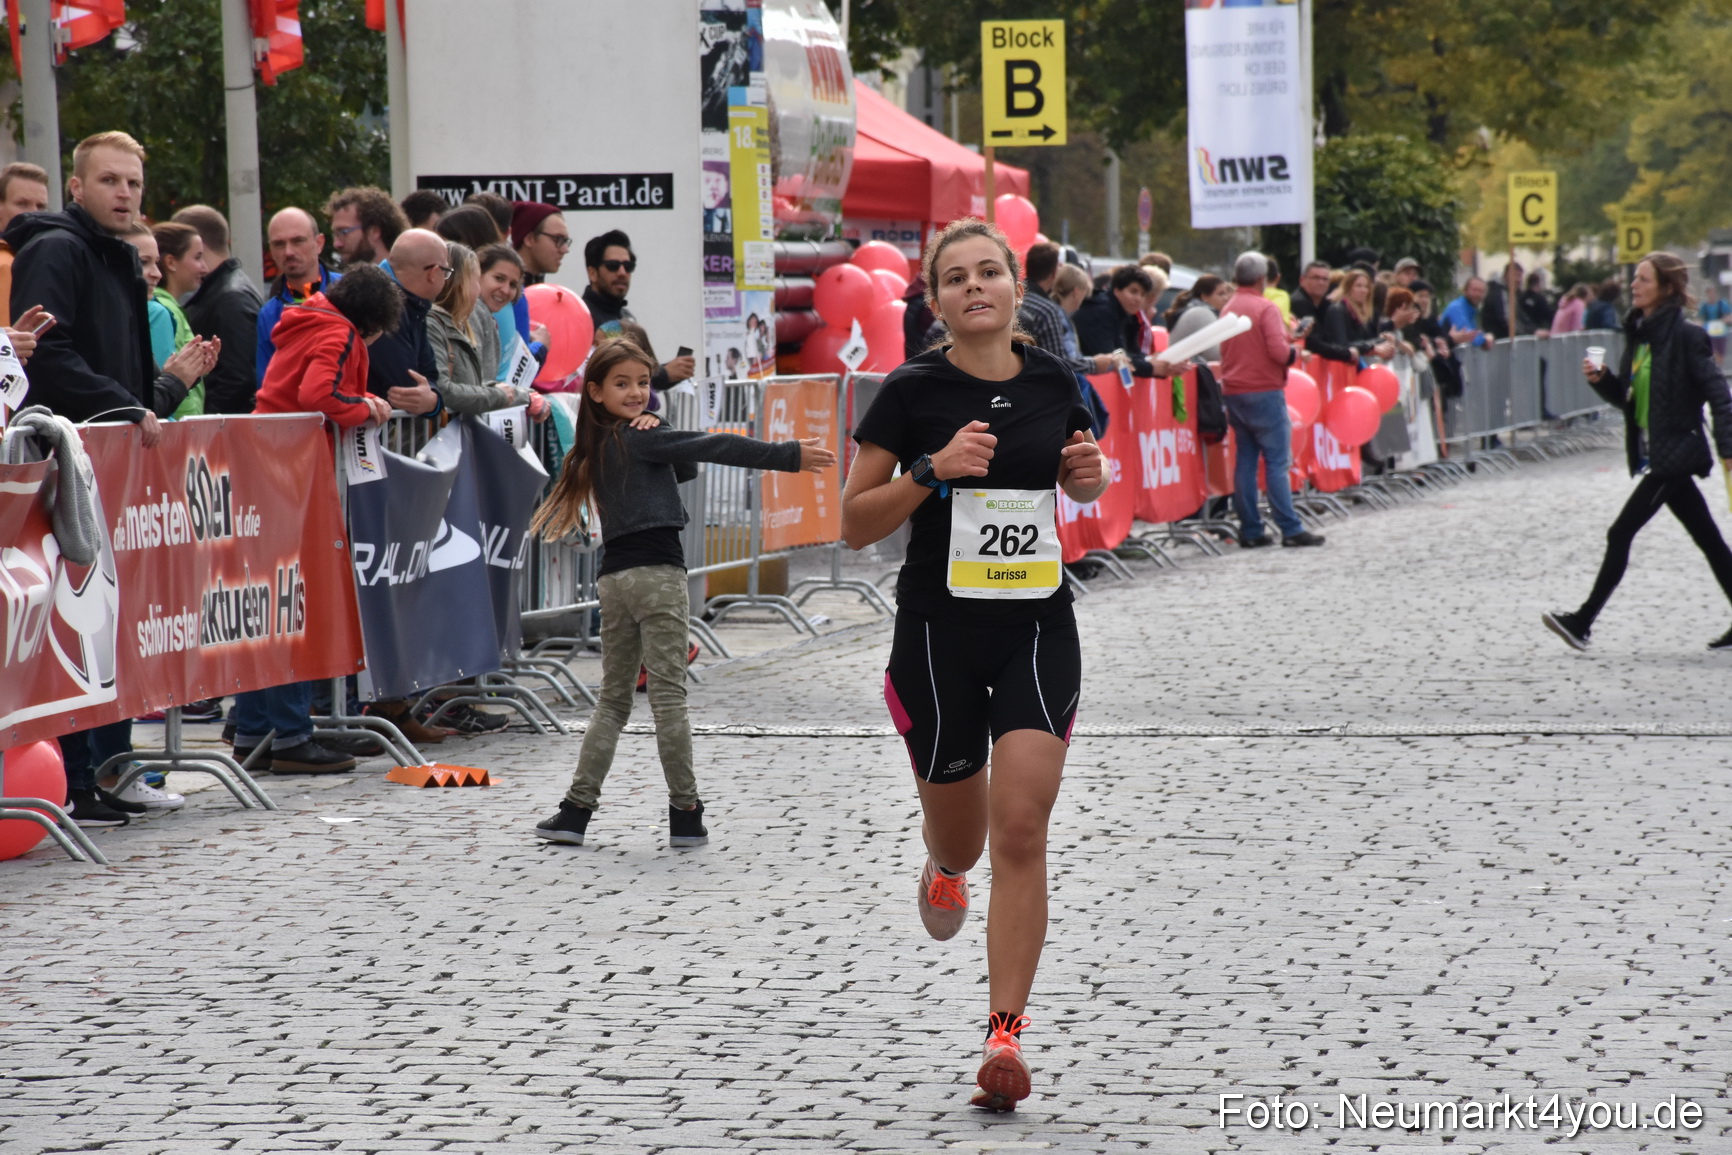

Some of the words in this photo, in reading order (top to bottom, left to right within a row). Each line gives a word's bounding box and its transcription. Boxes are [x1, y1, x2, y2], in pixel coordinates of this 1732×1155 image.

[992, 27, 1054, 48] Block
[1005, 60, 1044, 118] B
[733, 125, 757, 148] 18.
[1514, 176, 1550, 188] Block
[1520, 193, 1544, 226] C
[1626, 227, 1644, 251] D
[126, 486, 191, 550] meisten
[186, 456, 233, 543] 80er
[998, 500, 1035, 509] BOCK
[979, 524, 1039, 557] 262
[987, 568, 1027, 580] Larissa
